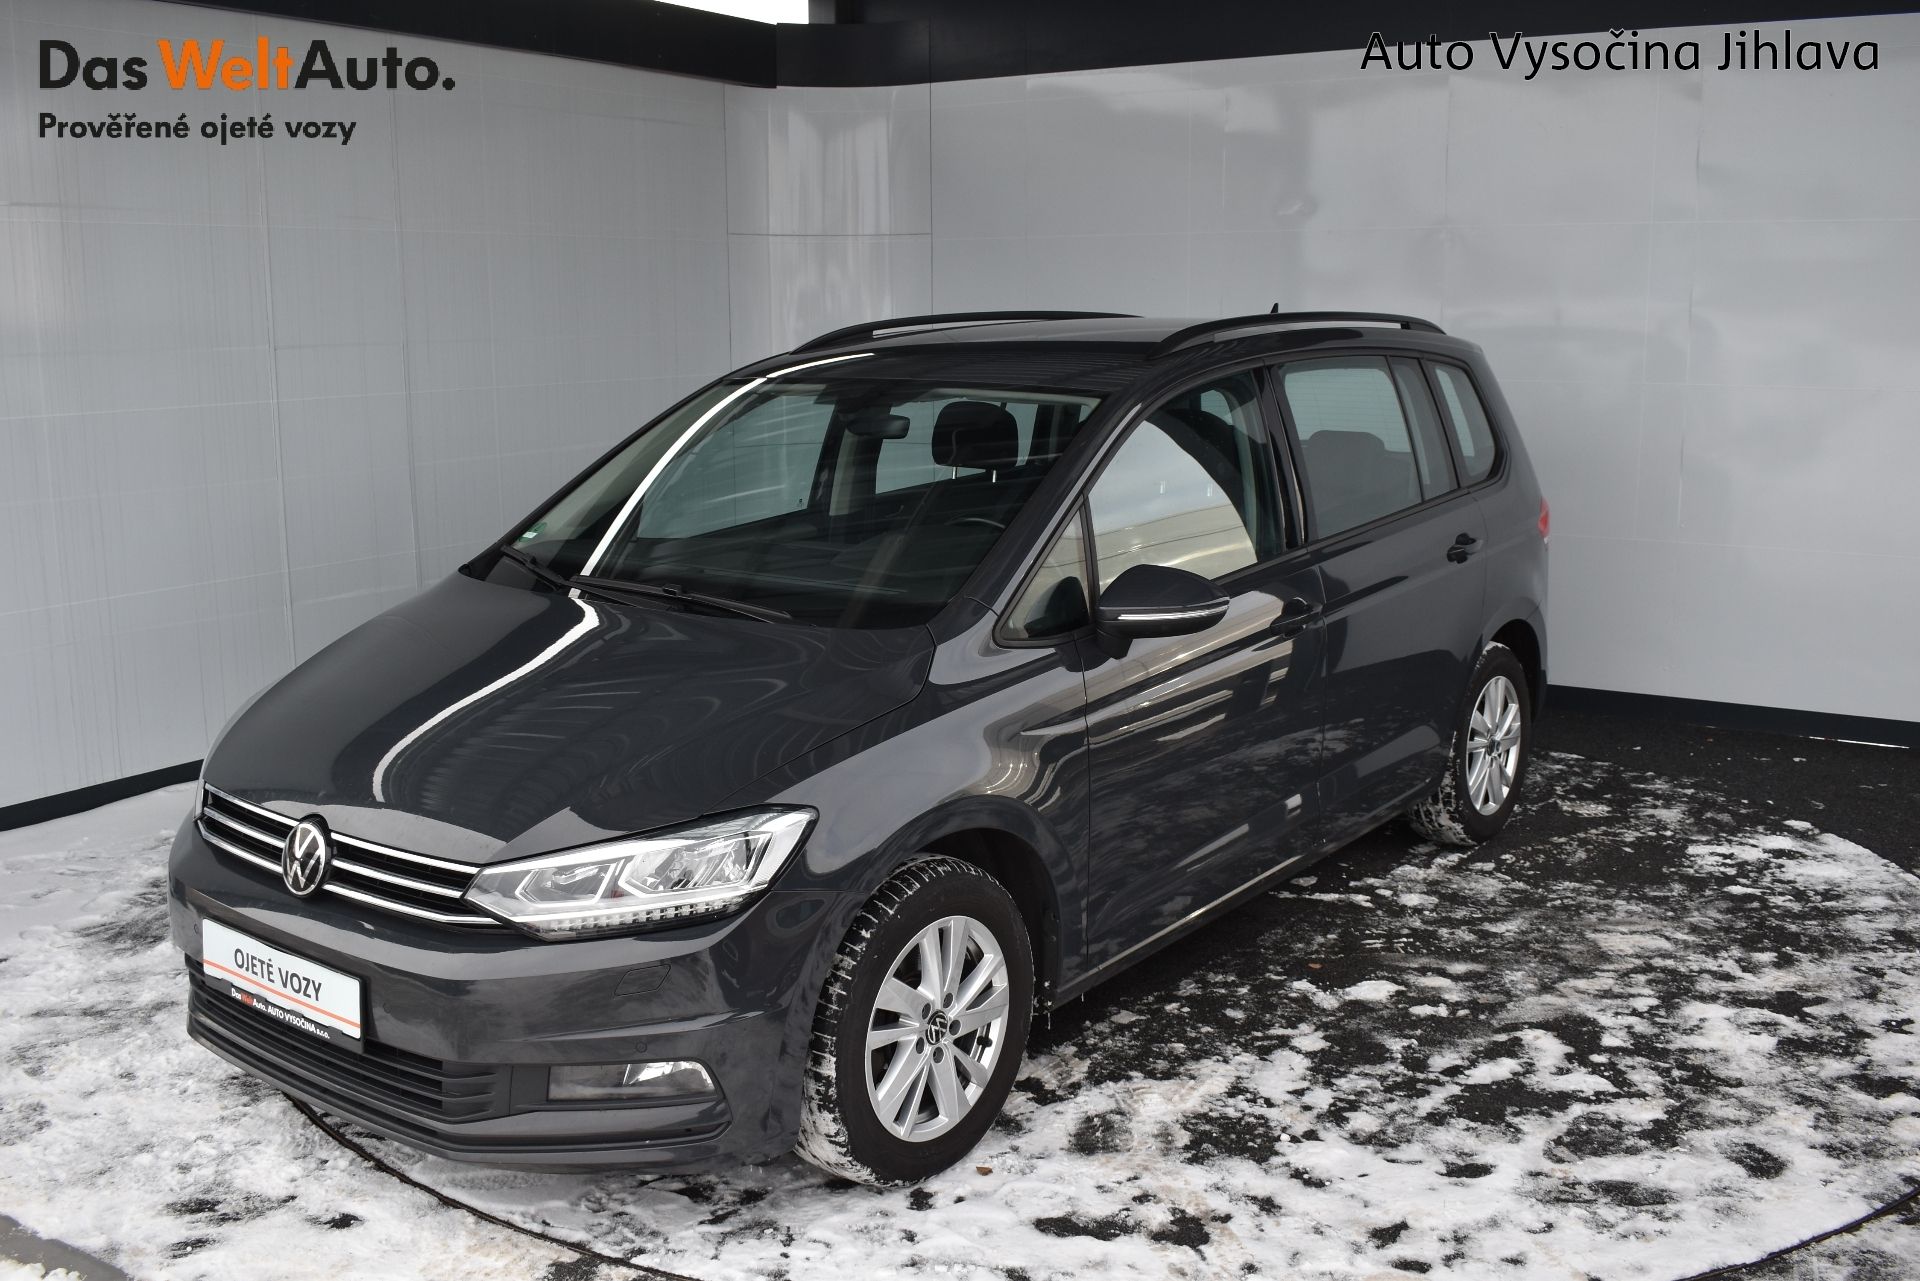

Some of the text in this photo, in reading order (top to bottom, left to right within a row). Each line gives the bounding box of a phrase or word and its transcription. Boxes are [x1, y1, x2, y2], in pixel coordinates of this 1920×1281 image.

[234, 948, 322, 1002] OJETÉ VOZY
[268, 1005, 284, 1019] AUTO
[284, 1012, 316, 1033] VYSOČINA
